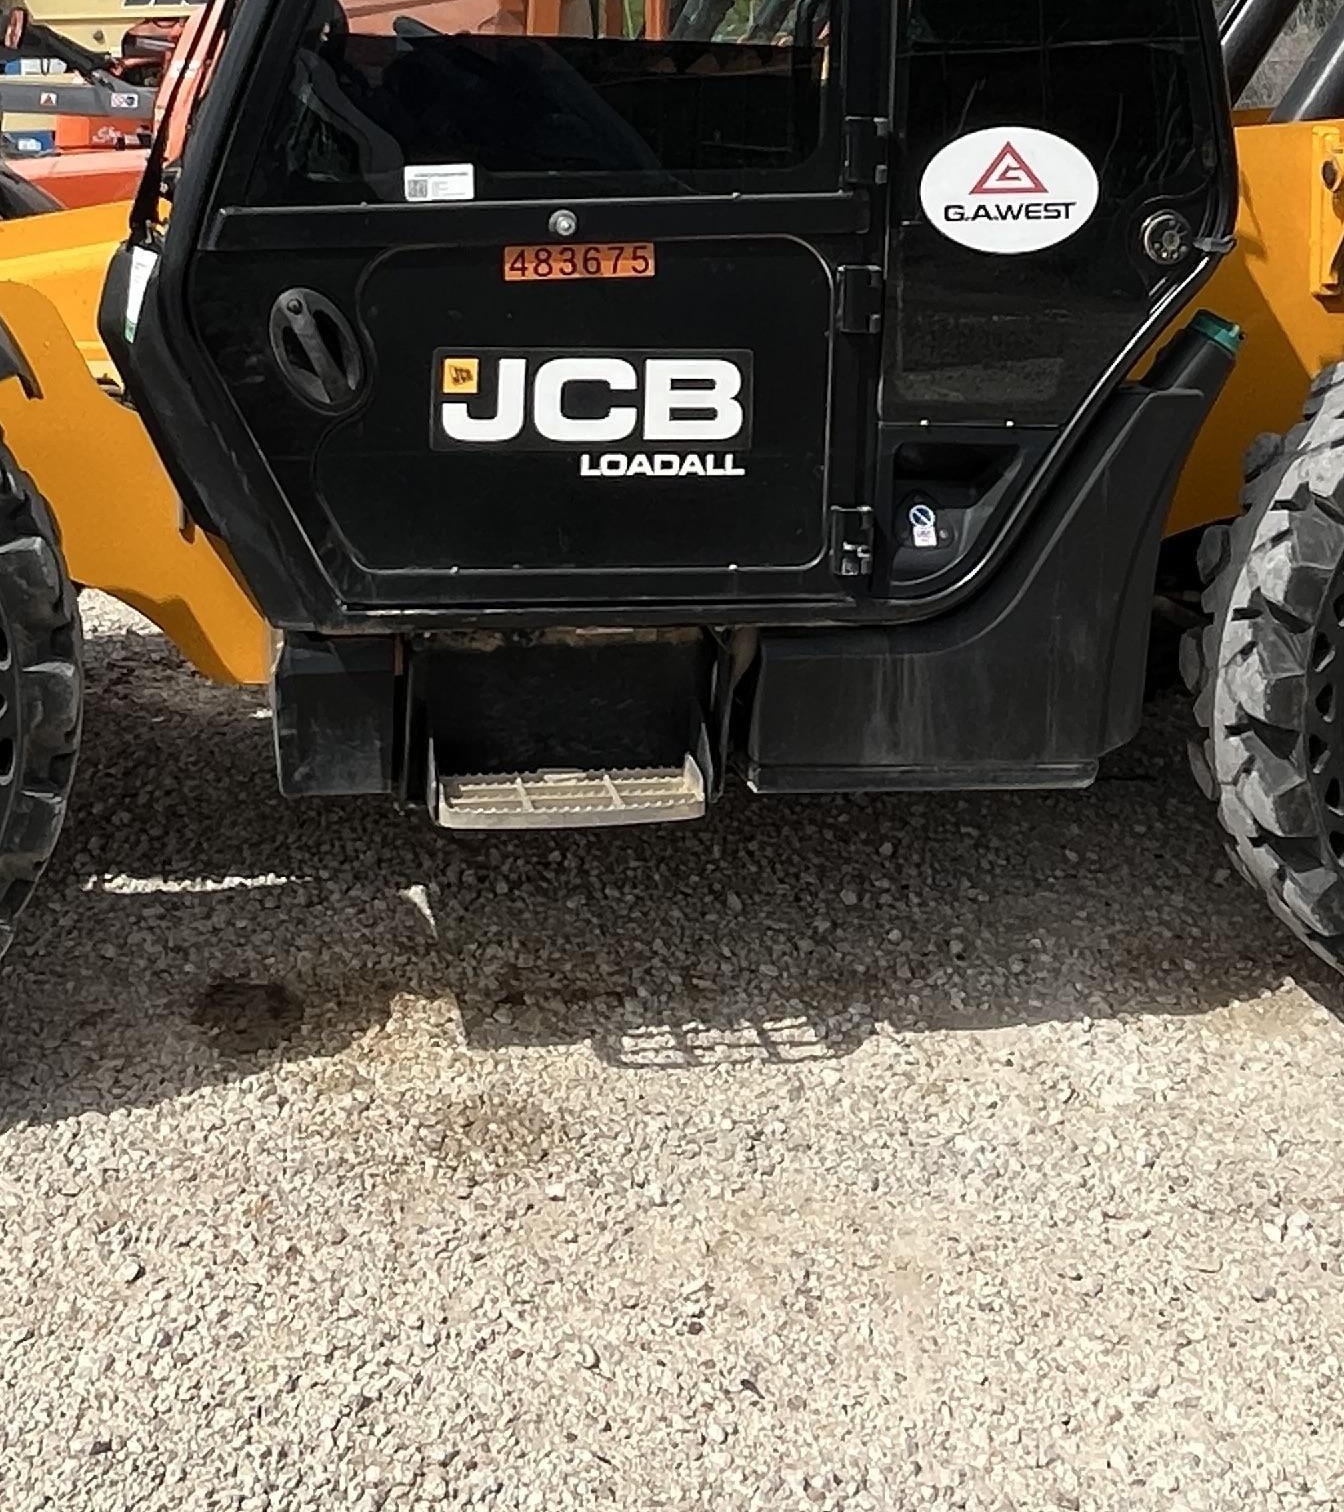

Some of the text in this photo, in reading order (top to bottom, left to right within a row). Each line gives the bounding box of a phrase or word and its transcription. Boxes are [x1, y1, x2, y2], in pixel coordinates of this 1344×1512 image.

[508, 244, 650, 278] 483675
[442, 358, 743, 442] JCB
[579, 453, 745, 477] LOADALL
